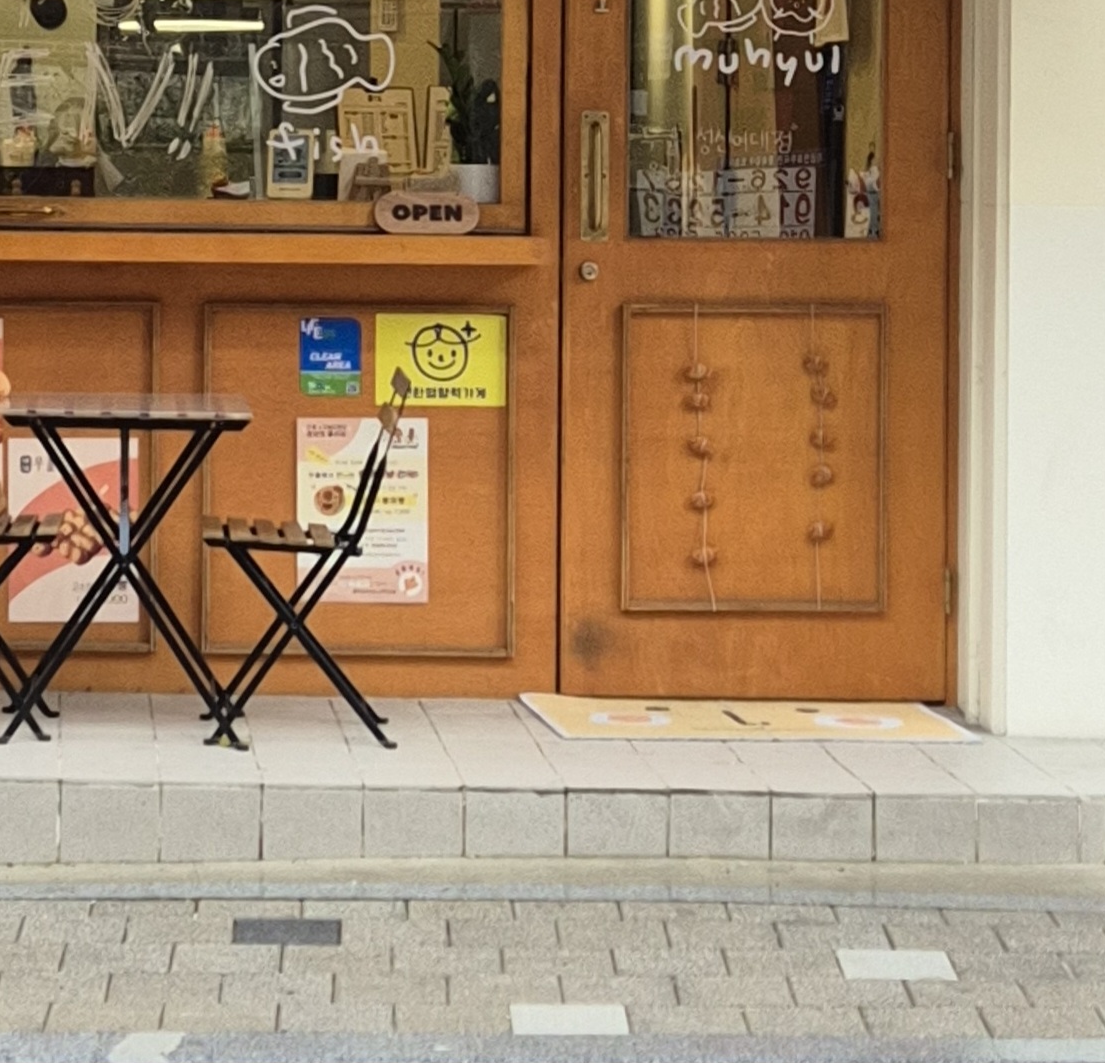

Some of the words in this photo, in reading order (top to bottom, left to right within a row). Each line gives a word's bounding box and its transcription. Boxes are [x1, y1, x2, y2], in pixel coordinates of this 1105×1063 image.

[674, 38, 841, 86] muhyul
[266, 122, 380, 163] fish
[392, 205, 463, 221] OPEN
